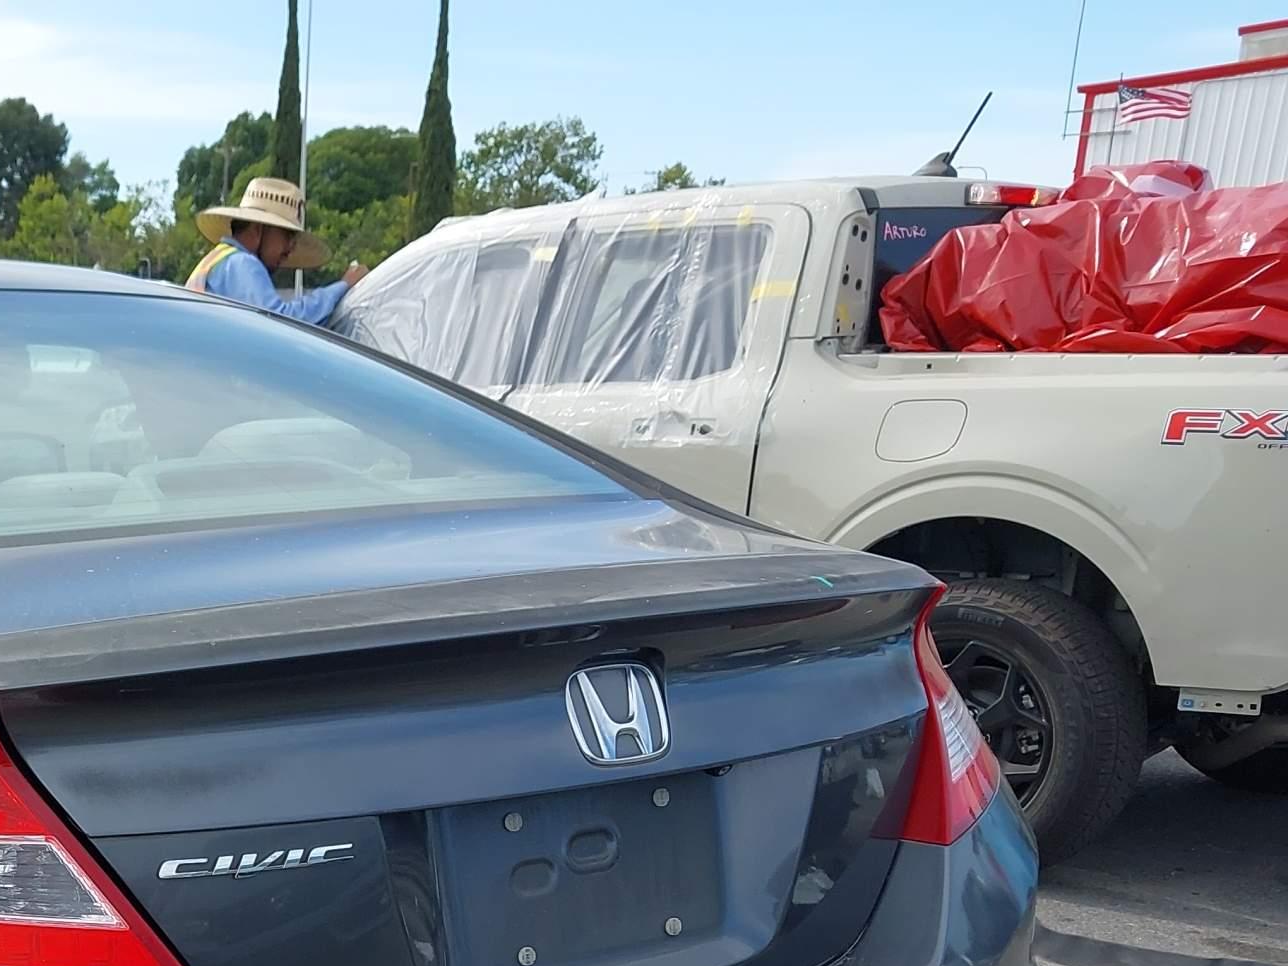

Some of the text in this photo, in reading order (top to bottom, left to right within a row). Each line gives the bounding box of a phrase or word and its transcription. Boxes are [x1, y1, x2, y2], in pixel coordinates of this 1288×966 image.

[884, 221, 927, 241] ARTURO
[1160, 407, 1288, 446] FX
[158, 843, 354, 880] CIVIC
